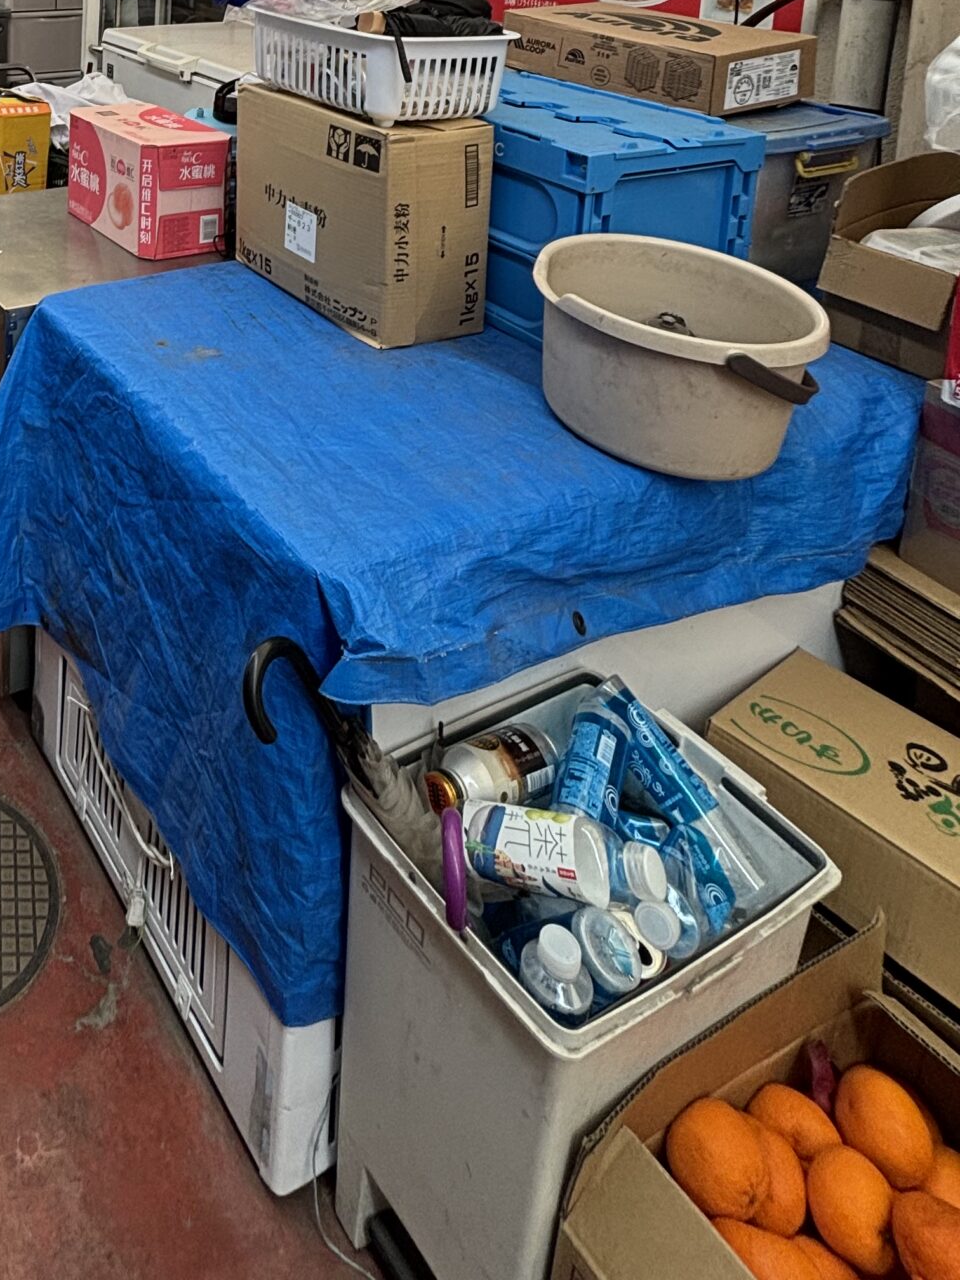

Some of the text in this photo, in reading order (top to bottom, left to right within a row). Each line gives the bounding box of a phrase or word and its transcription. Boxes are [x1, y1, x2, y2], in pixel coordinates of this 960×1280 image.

[524, 45, 546, 55] COOP
[526, 37, 556, 50] AURORA
[71, 163, 100, 195] 水蜜桃
[179, 164, 216, 180] 水蜜桃
[265, 184, 328, 228] 中力粉
[393, 202, 410, 283] 中力小麦粉
[332, 298, 368, 322] ニップン
[749, 702, 842, 766] すいか
